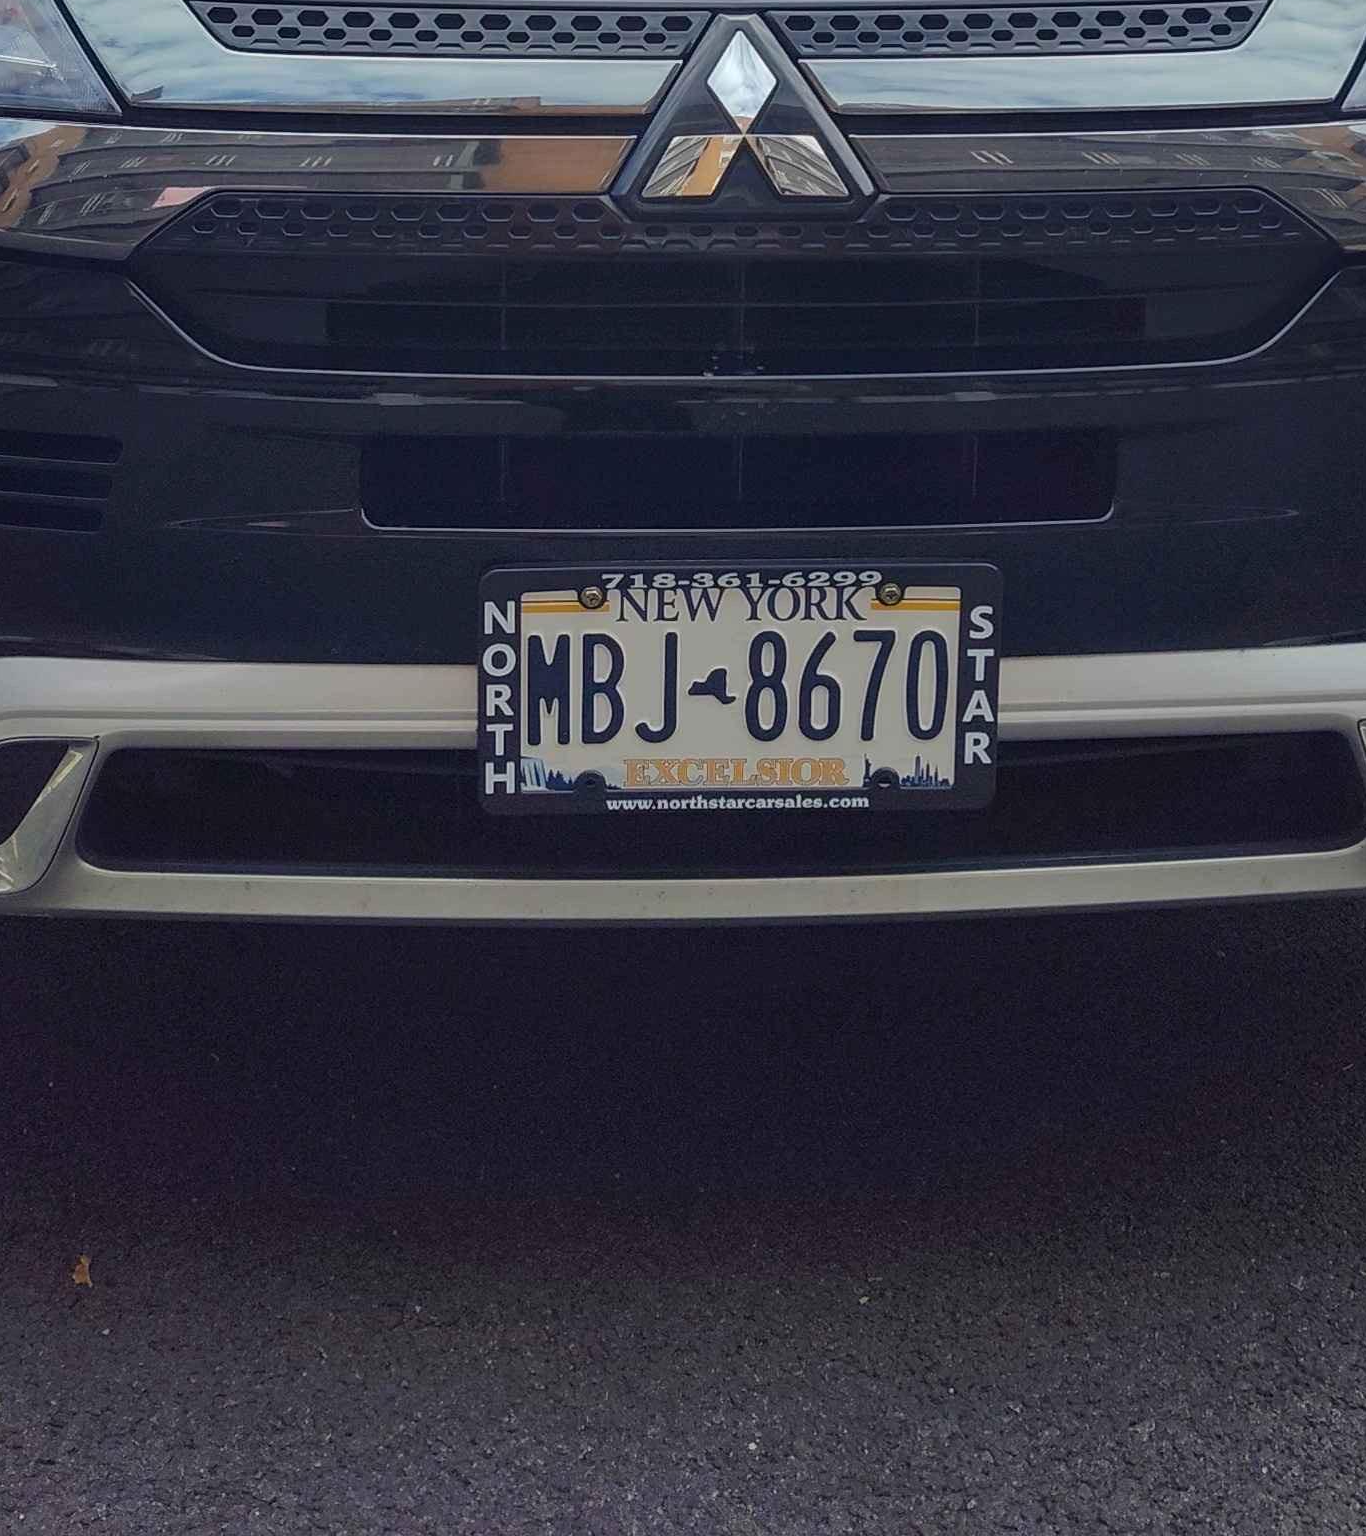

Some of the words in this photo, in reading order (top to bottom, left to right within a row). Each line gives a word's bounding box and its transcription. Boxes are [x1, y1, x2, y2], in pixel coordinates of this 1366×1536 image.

[602, 571, 882, 589] 718-361-6299
[615, 588, 723, 622] NEW
[744, 587, 868, 621] YORK
[483, 600, 517, 795] NORTH
[527, 633, 678, 745] MBJ
[745, 630, 949, 742] 8670
[963, 604, 995, 767] STAR
[622, 756, 850, 789] EXCELSIOR
[606, 794, 870, 812] www.northstarcarsales.com
